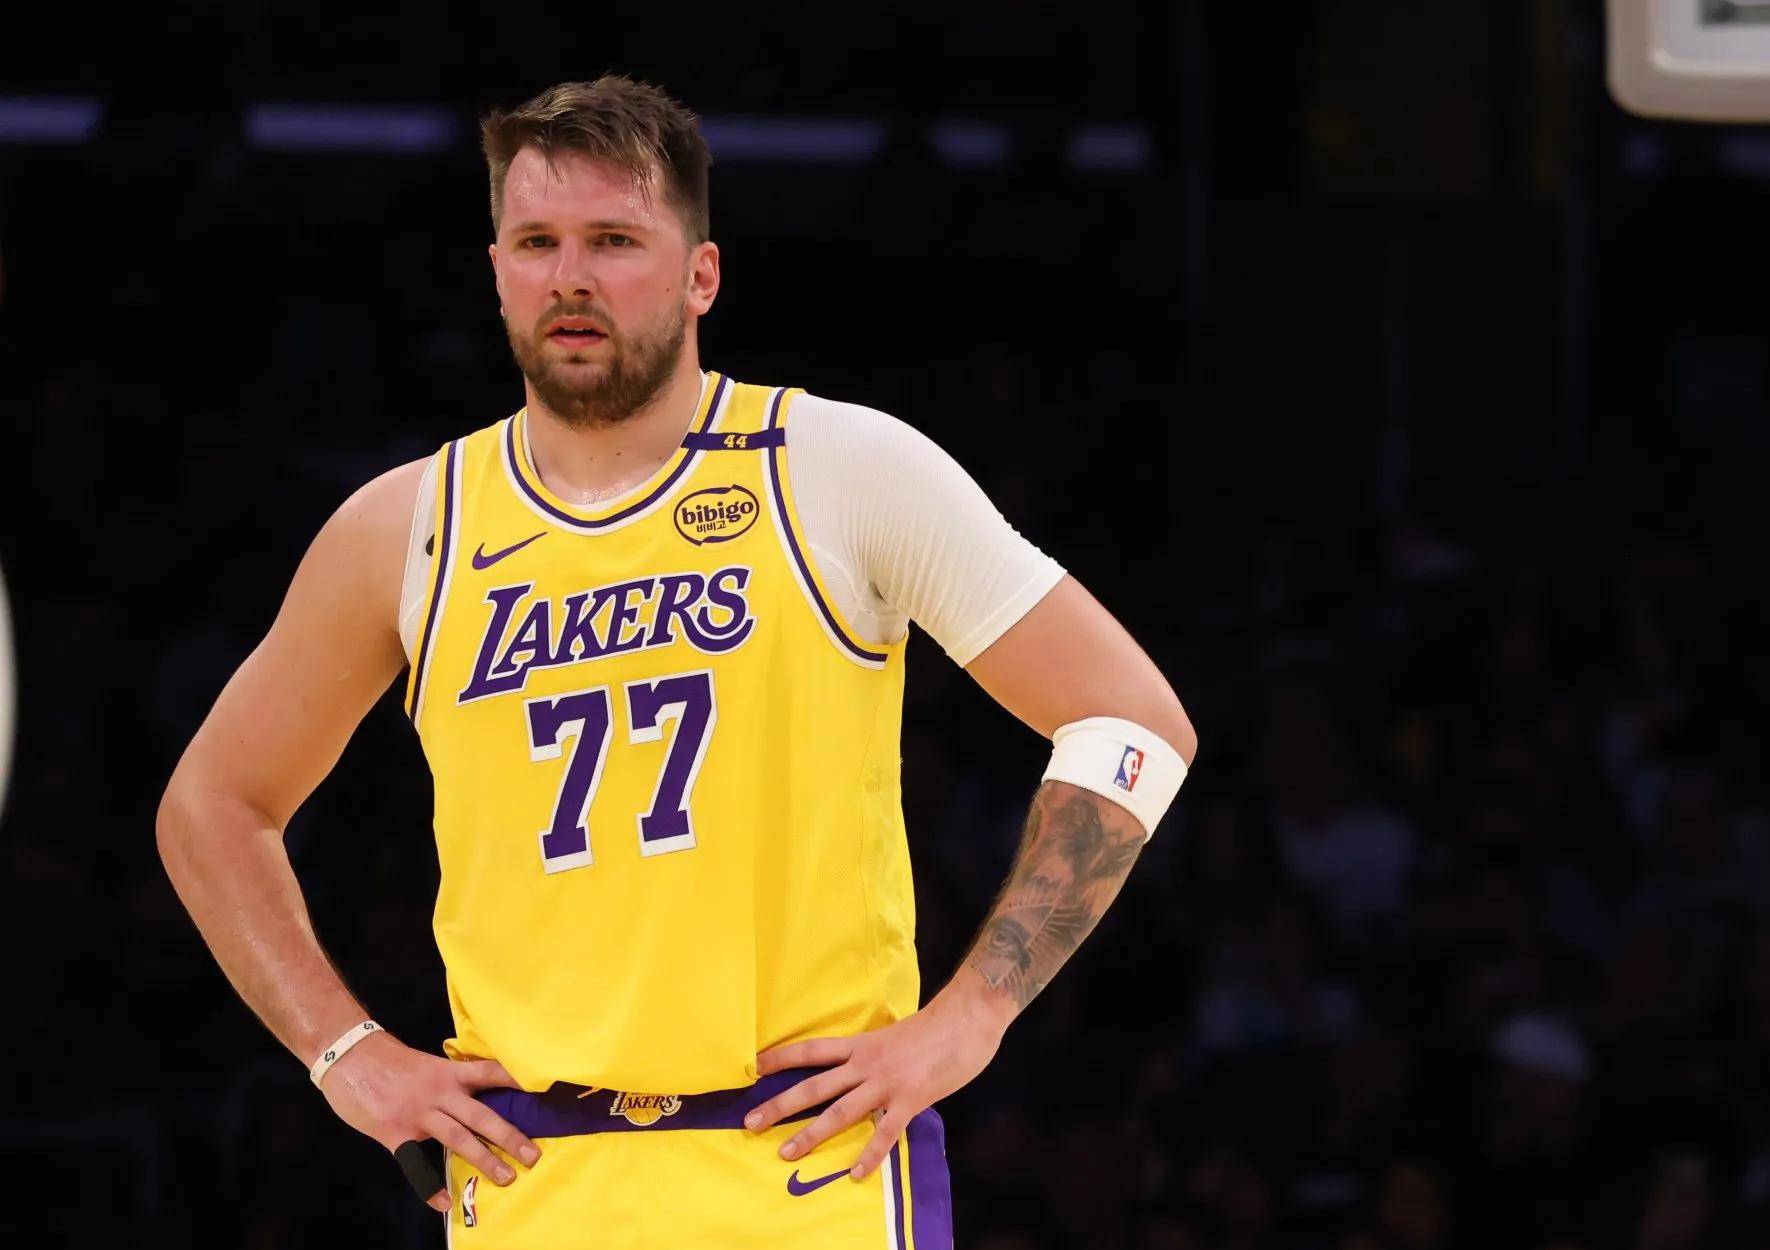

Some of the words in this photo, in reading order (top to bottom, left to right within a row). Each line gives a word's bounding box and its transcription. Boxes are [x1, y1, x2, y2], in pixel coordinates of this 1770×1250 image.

[723, 433, 748, 449] 44
[681, 501, 754, 526] bibigo
[457, 565, 758, 705] LAKERS
[523, 668, 719, 875] 77
[609, 1090, 683, 1117] LAKERS
